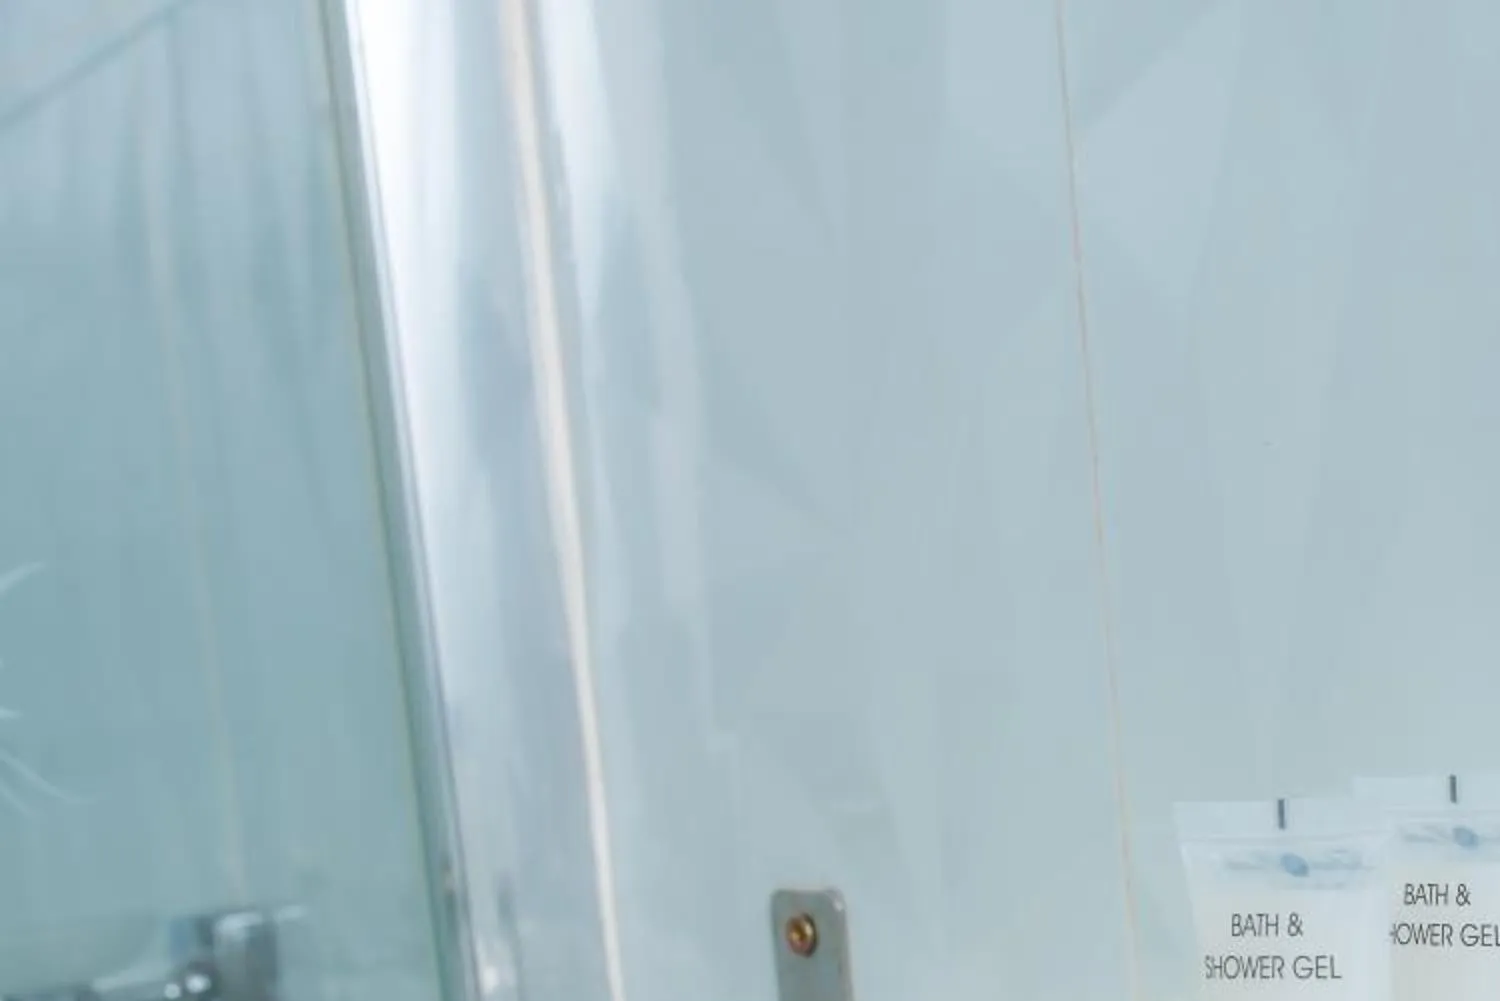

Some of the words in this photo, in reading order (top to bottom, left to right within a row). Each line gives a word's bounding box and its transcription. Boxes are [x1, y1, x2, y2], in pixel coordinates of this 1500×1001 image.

[1403, 882, 1449, 907] BATH
[1455, 882, 1472, 907] &
[1230, 911, 1280, 938] BATH
[1286, 910, 1304, 938] &
[1389, 922, 1454, 948] HOWER
[1203, 953, 1285, 981] SHOWER
[1292, 953, 1343, 981] GEL
